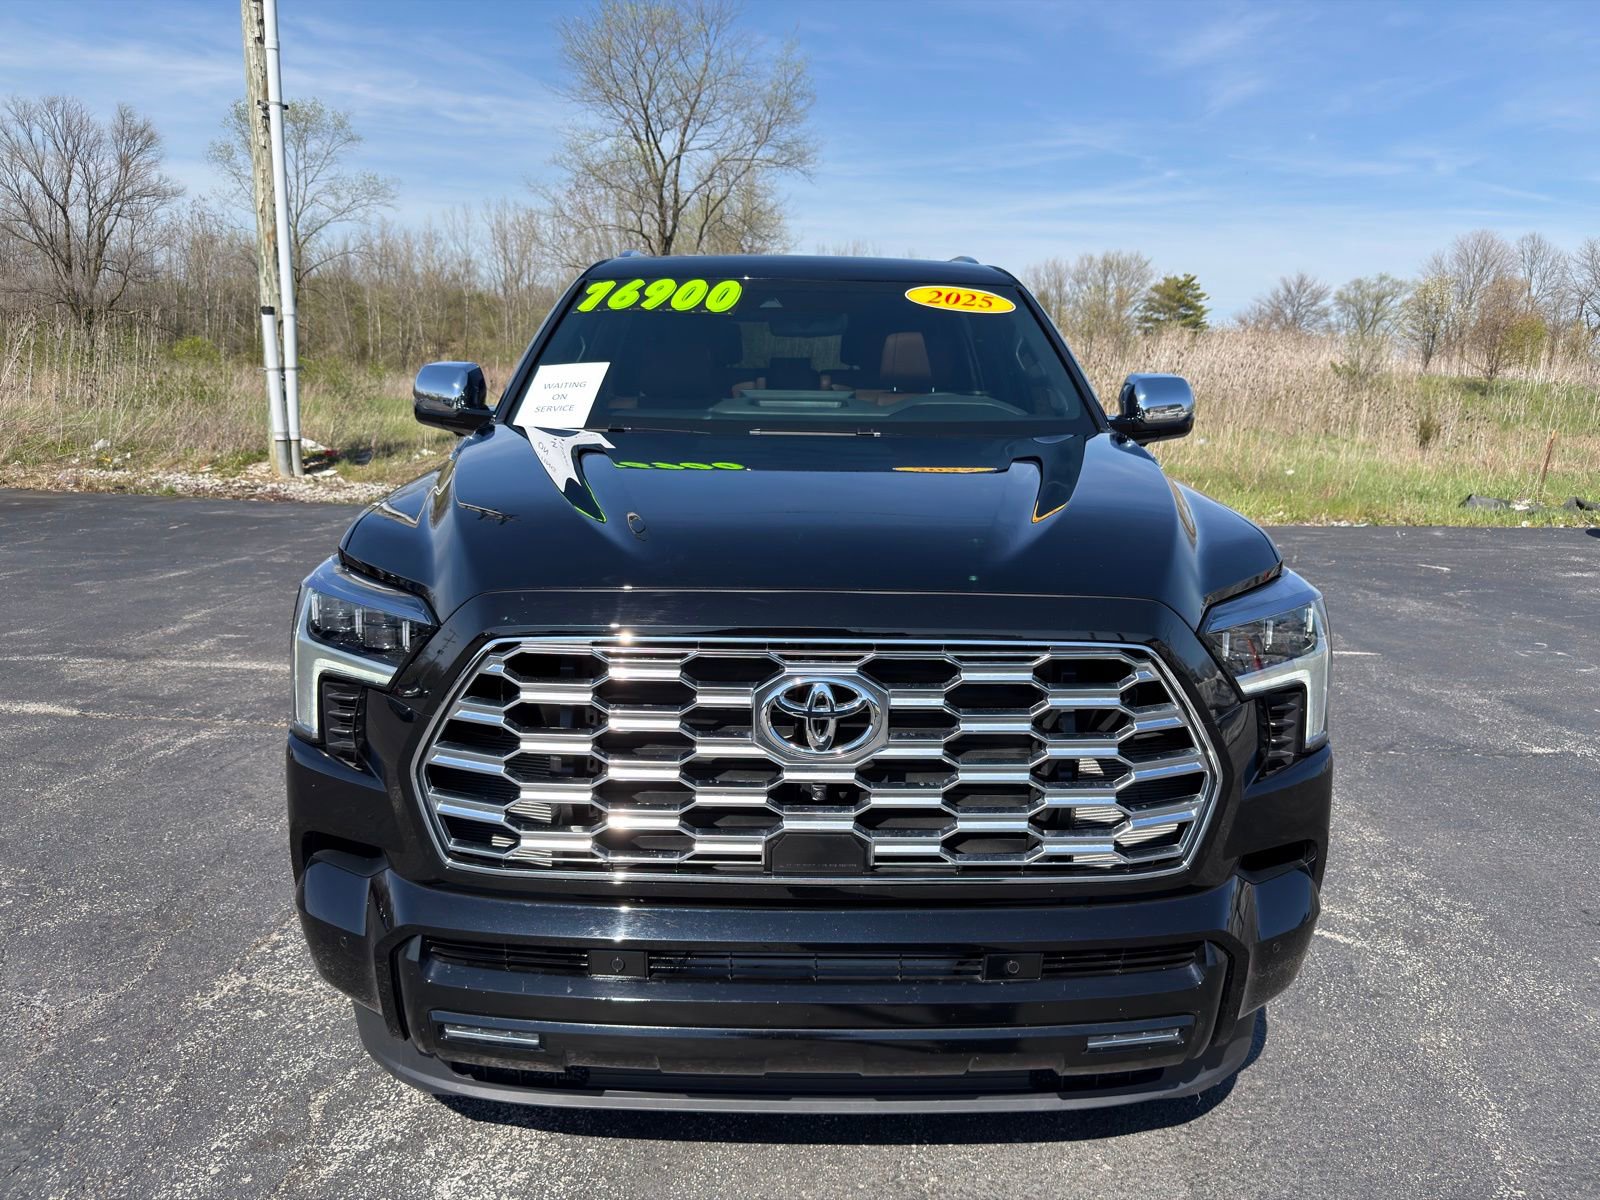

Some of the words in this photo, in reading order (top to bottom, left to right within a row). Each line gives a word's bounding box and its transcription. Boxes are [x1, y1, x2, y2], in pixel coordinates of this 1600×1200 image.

[577, 279, 742, 312] 76900
[926, 290, 994, 308] 2025
[543, 381, 587, 390] WAITING
[551, 393, 568, 401] ON
[534, 404, 575, 413] SERVICE
